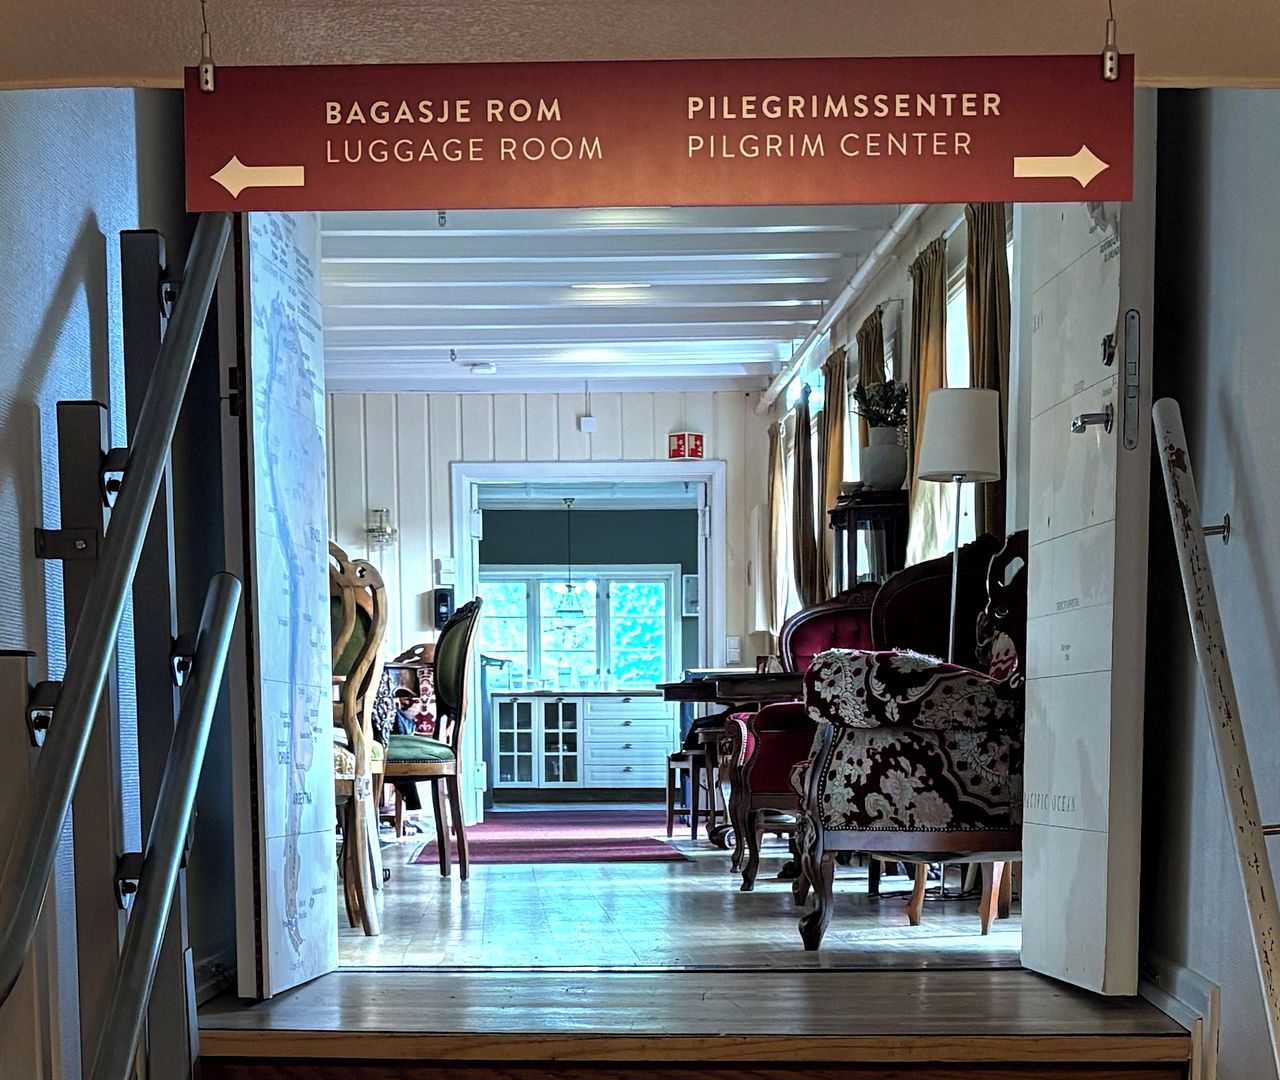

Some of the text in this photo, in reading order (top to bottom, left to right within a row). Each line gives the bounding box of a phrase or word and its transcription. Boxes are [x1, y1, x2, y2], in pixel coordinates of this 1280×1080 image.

[326, 98, 562, 125] BAGASJE ROM
[687, 92, 1003, 121] PILEGRIMSSENTER
[327, 135, 604, 164] LUGGAGE ROOM
[687, 131, 973, 159] PILGRIM CENTER
